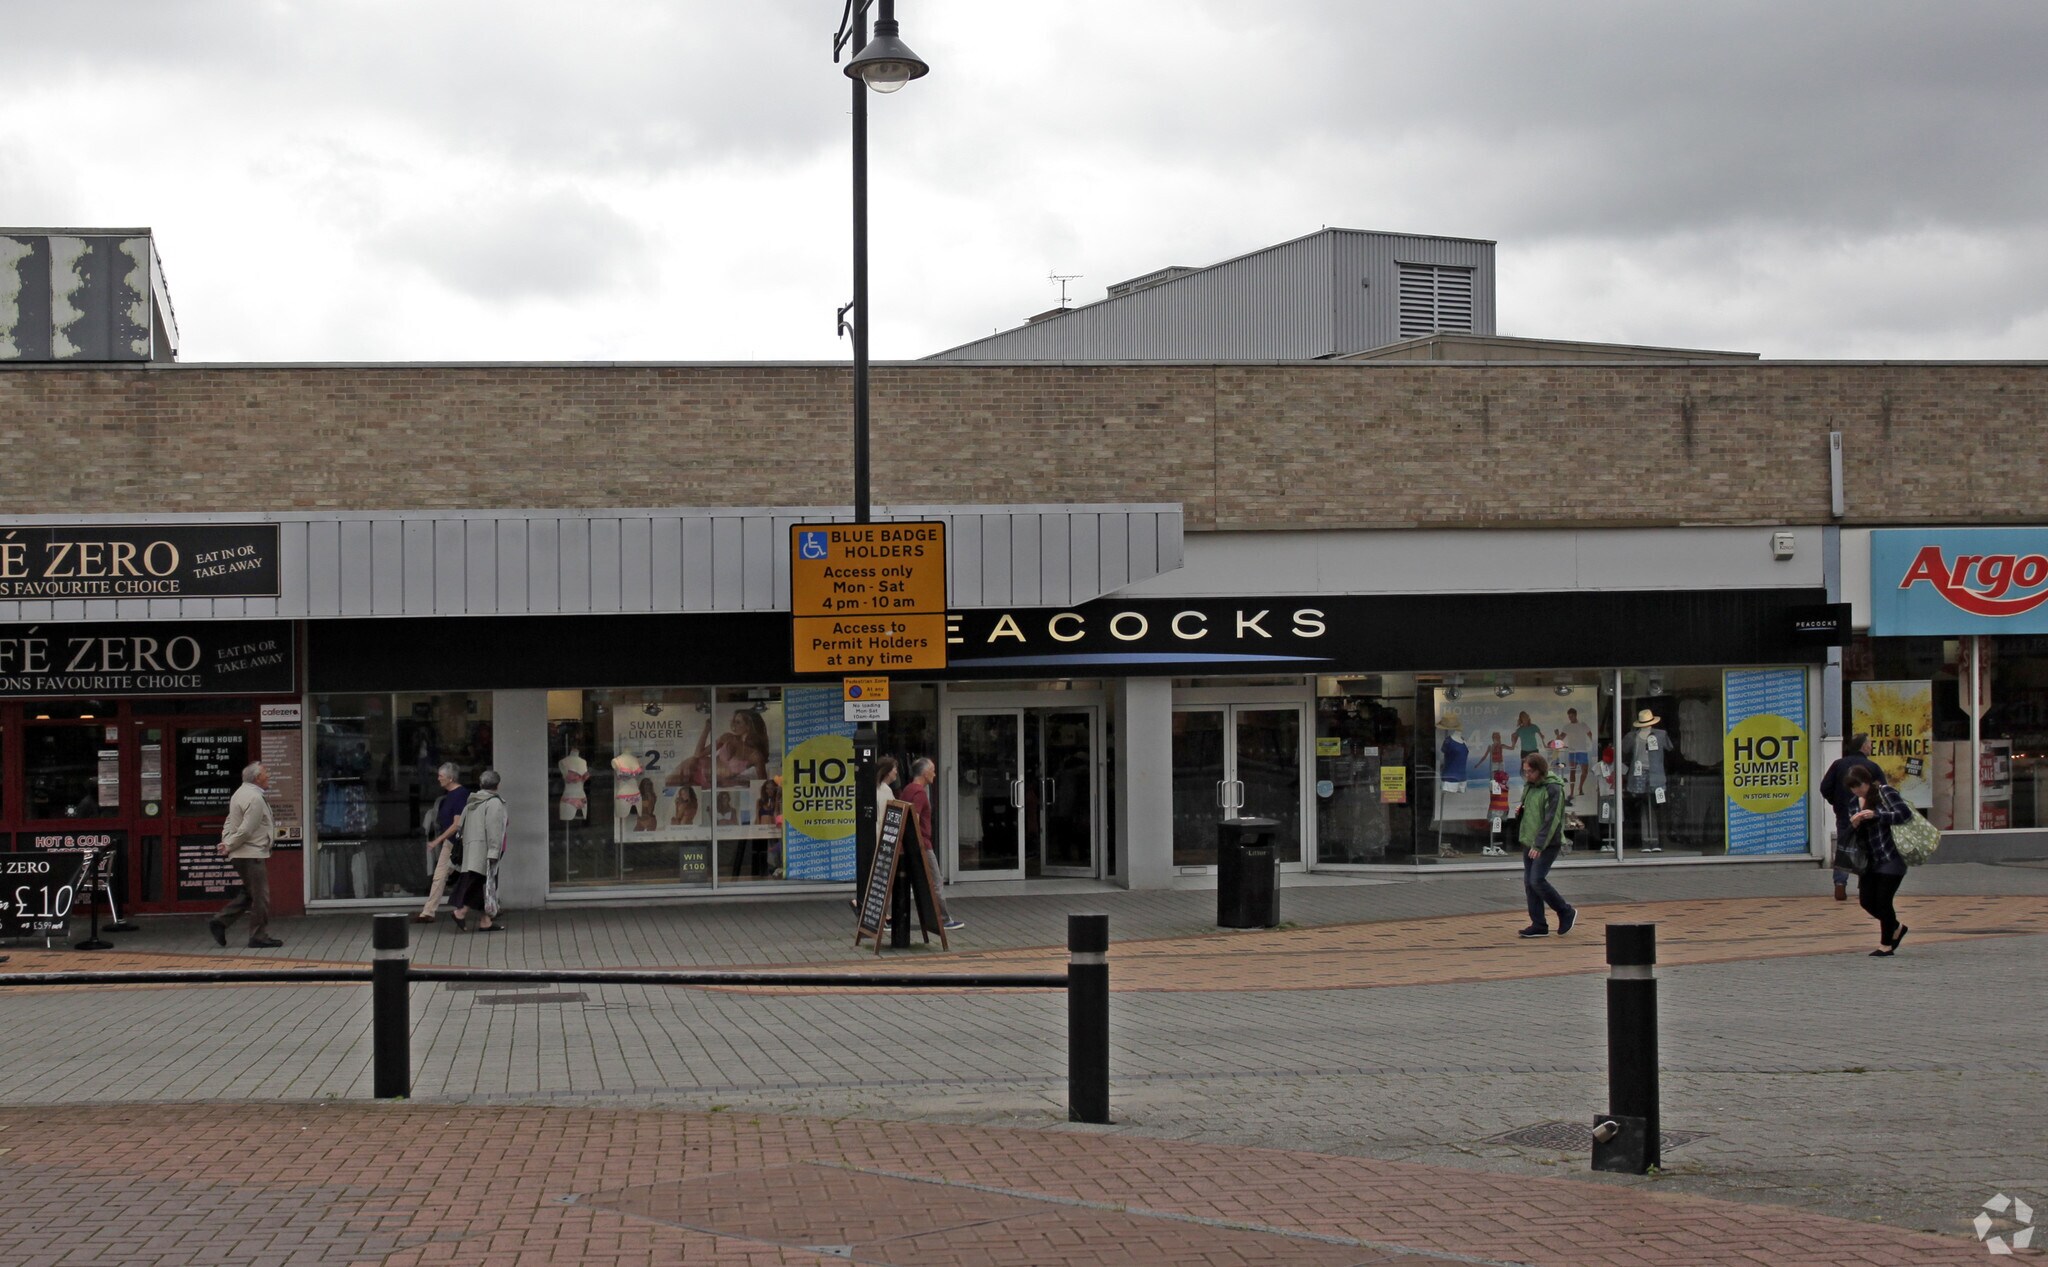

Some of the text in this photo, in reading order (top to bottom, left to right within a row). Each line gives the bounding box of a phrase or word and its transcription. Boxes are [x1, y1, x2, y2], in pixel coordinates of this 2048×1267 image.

[832, 529, 937, 542] BLUE BADGE
[196, 545, 256, 564] EAT IN OR
[845, 545, 924, 558] HOLDERS
[43, 540, 180, 578] ZERO
[194, 558, 263, 579] TAKE AWAY
[824, 564, 913, 578] Access only
[14, 580, 111, 594] FAVOURITE
[115, 580, 180, 593] CHOICE
[834, 582, 866, 593] Mon
[878, 580, 904, 592] Sat
[1898, 546, 2048, 616] Argo
[822, 598, 832, 610] 4
[836, 599, 859, 610] pm
[872, 596, 889, 608] 10
[893, 598, 914, 608] am
[833, 622, 906, 634] Access to
[948, 608, 1326, 644] EACOCKS
[218, 640, 276, 659] EAT IN OR
[812, 637, 928, 650] Permit Holders
[65, 636, 201, 672] ZERO
[827, 652, 913, 667] at any time
[215, 652, 284, 674] TAKE AWAY
[0, 674, 201, 690] ONS FAVOURITE CHOICE
[1728, 675, 1765, 684] REDUCTIONS
[1766, 670, 1802, 679] REDUCTIONS
[1728, 678, 1802, 692] REDUCTIONS REDUCTIONS
[1728, 685, 1802, 699] REDUCTIONS REDUCTIONS
[788, 694, 828, 703] REDUCTIONS
[1728, 692, 1802, 707] REDUCTIONS REDUCTIONS
[788, 702, 828, 711] REDUCTIONS
[1443, 705, 1499, 715] HOLIDAY
[1728, 699, 1802, 714] REDUCTIONS REDUCTIONS
[788, 710, 828, 718] REDUCTIONS
[630, 720, 682, 730] SUMMER
[788, 717, 828, 727] REDUCTIONS
[629, 730, 683, 739] LINGERIE
[788, 725, 828, 734] REDUCTIONS
[1870, 724, 1912, 737] THE BIG
[1734, 736, 1799, 761] HOT
[1870, 739, 1929, 756] EARANCE
[794, 758, 856, 784] HO
[1734, 762, 1799, 774] SUMMER
[1734, 774, 1799, 786] OFFERS!!
[794, 786, 855, 798] SUMME
[792, 799, 852, 811] OFFERS
[1730, 810, 1804, 825] REDUCTIONS REDUCTIONS
[1730, 817, 1804, 832] REDUCTIONS REDUCTIONS
[1730, 824, 1804, 840] REDUCTIONS REDUCTIONS
[35, 835, 110, 847] HOT & COLD
[789, 841, 830, 852] REDUCTIONS
[1730, 832, 1804, 847] REDUCTIONS REDUCTIONS
[789, 849, 830, 860] REDUCTIONS
[6, 862, 50, 874] ZERO
[789, 858, 830, 867] REDUCTIONS
[789, 865, 830, 876] REDUCTIONS
[15, 885, 72, 917] £10
